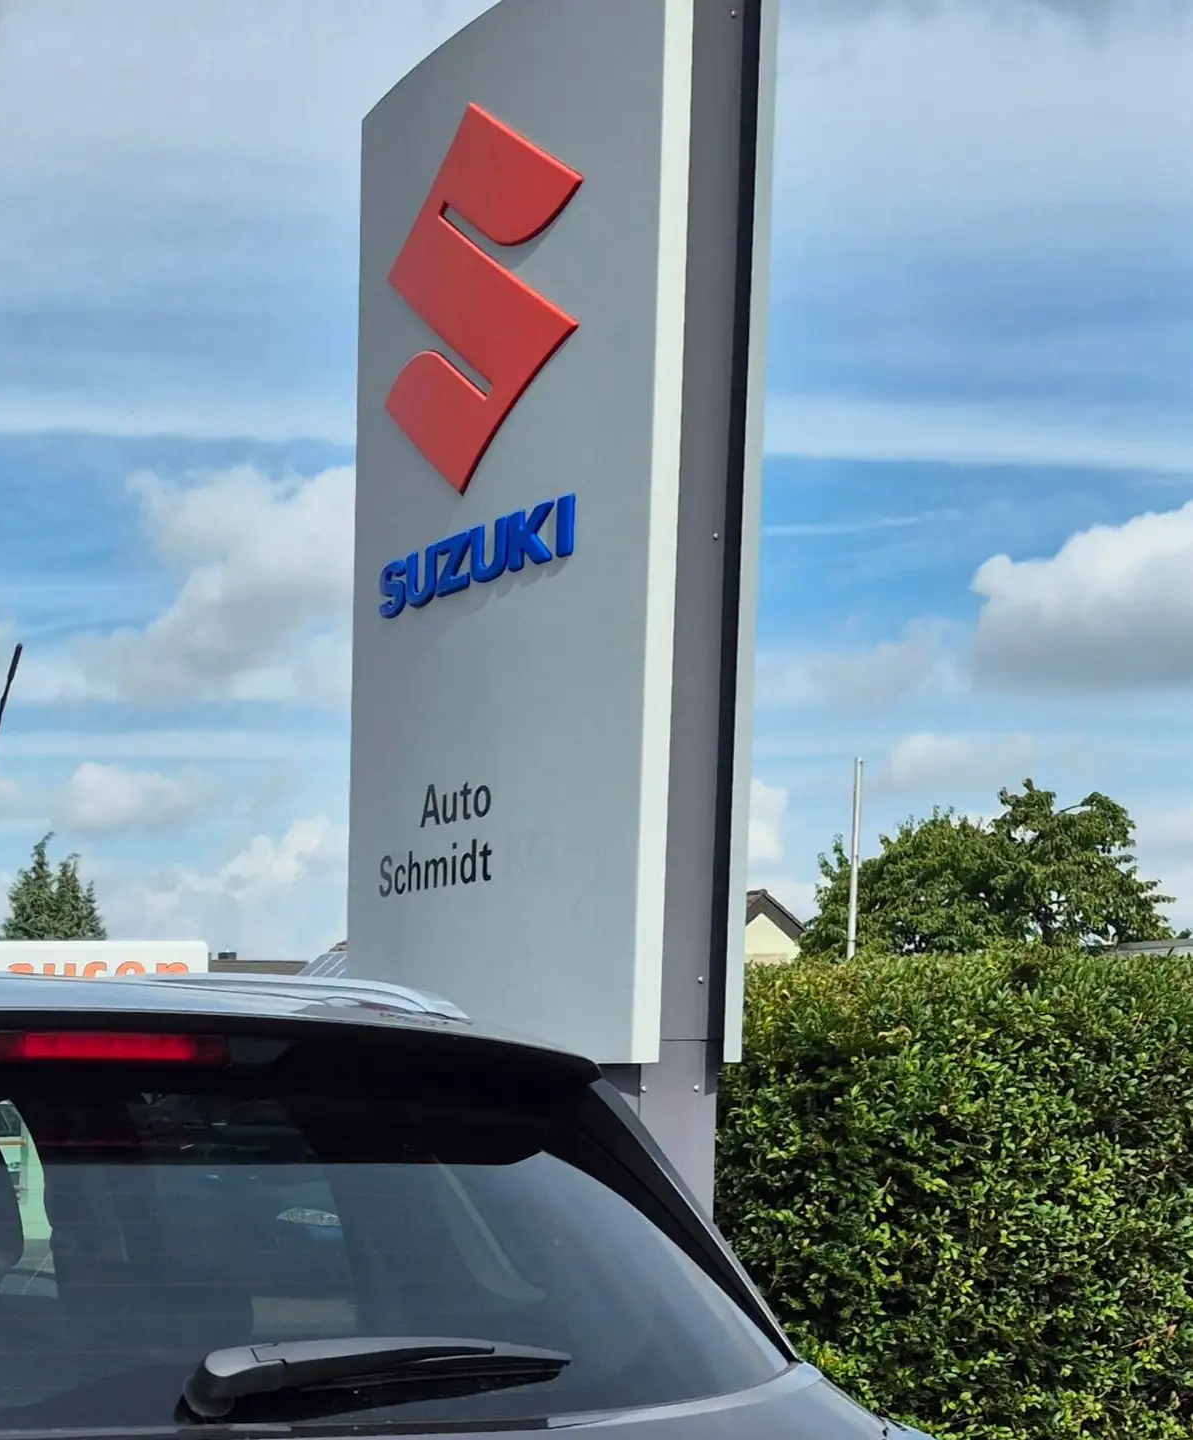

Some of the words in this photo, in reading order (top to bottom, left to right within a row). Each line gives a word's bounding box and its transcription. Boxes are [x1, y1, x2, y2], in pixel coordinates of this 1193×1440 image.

[379, 492, 575, 619] SUZUKI
[420, 780, 492, 828] Auto
[379, 838, 493, 898] Schmidt
